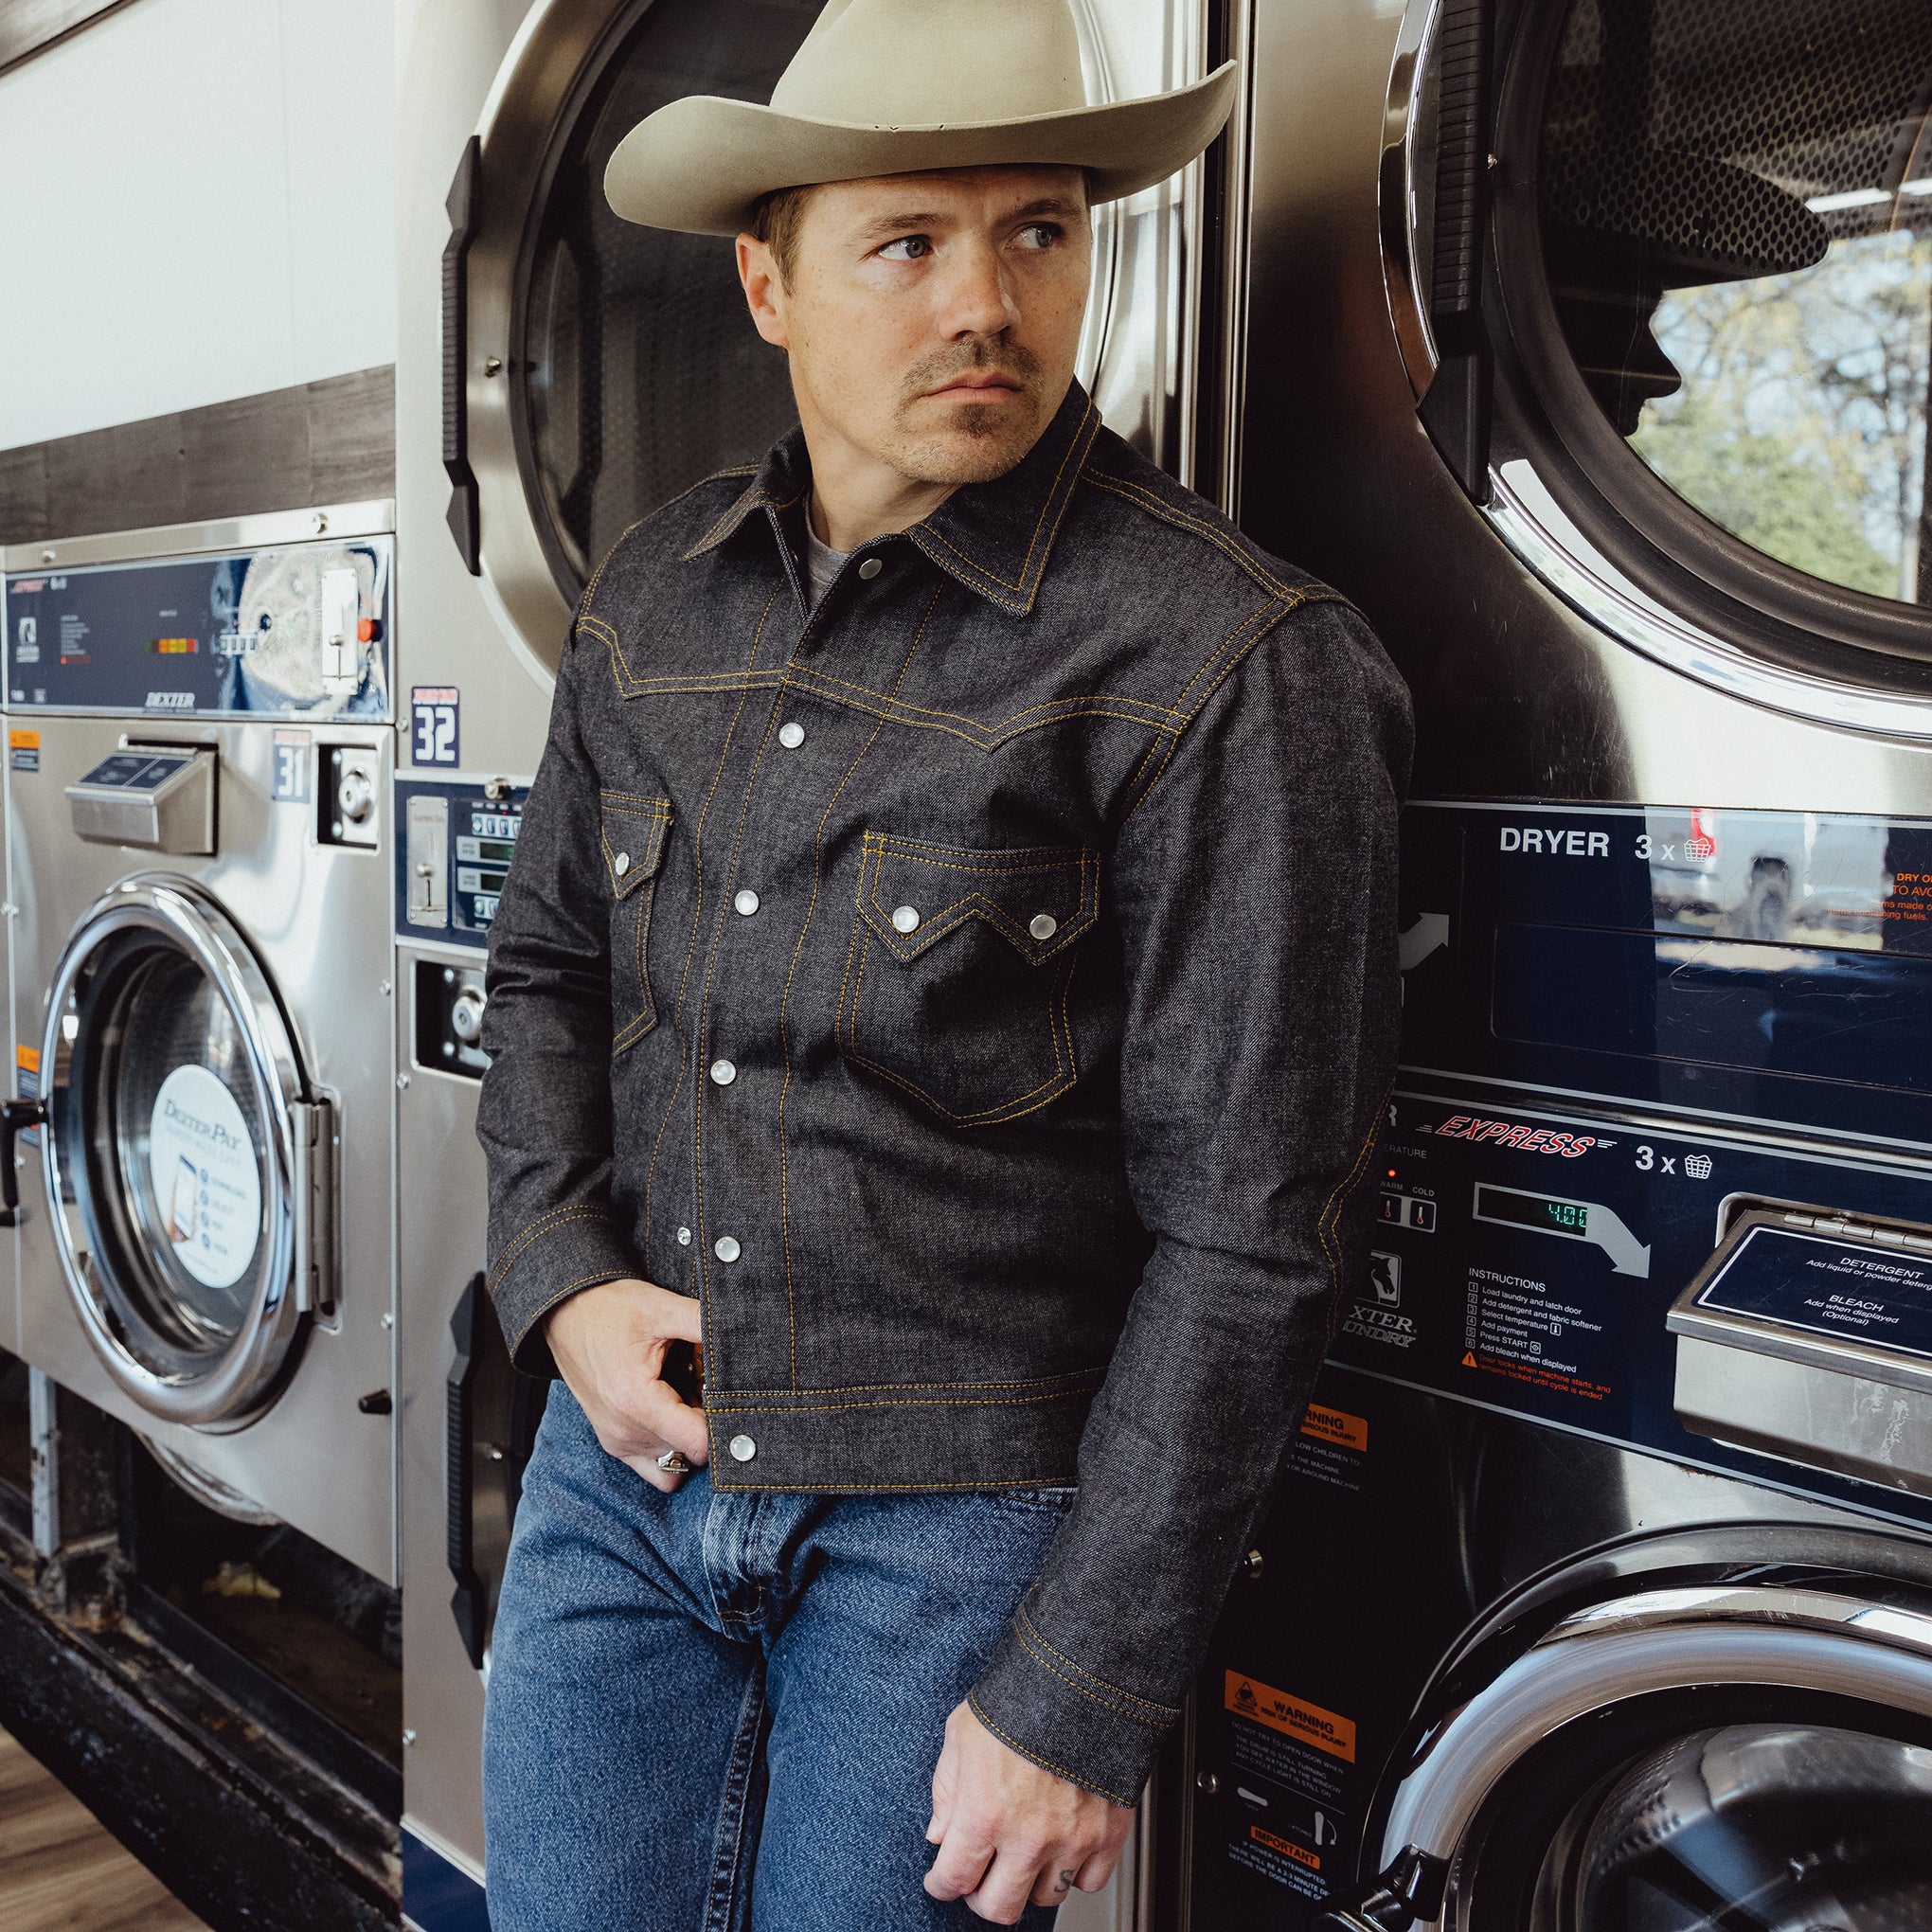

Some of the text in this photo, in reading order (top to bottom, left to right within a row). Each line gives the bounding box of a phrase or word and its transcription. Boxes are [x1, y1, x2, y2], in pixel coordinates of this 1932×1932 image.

[415, 707, 456, 761] 32
[277, 746, 304, 797] 31
[1500, 828, 1610, 857] DRYER
[1635, 834, 1653, 859] 3
[1892, 885, 1908, 895] TO
[1896, 873, 1920, 882] DRY
[1897, 902, 1923, 910] made
[1435, 1115, 1596, 1157] EXPRESS
[1635, 1145, 1676, 1174] 3 x
[1412, 1187, 1435, 1197] COLD
[1469, 1267, 1547, 1292] INSTRUCTIONS
[1806, 1260, 1827, 1268] Add
[1827, 1262, 1852, 1274] liquid
[1864, 1271, 1901, 1283] powder
[1840, 1257, 1924, 1279] DETERGENT
[1482, 1286, 1500, 1296] Load
[1502, 1290, 1529, 1304] laundry
[1530, 1297, 1544, 1307] and
[1545, 1300, 1563, 1311] latch
[1564, 1305, 1582, 1315] door
[1804, 1298, 1900, 1324] Add when displayed
[1829, 1295, 1885, 1312] BLEACH
[1481, 1309, 1504, 1320] Select
[1505, 1315, 1548, 1331] temperature
[1482, 1297, 1496, 1307] Add
[1498, 1301, 1531, 1316] detergent
[1533, 1309, 1547, 1319] and
[1549, 1313, 1569, 1324] fabric
[1570, 1318, 1602, 1333] softener
[1822, 1310, 1869, 1326] (Optional)
[1480, 1331, 1500, 1342] Press
[1501, 1336, 1529, 1349] START
[1481, 1320, 1495, 1330] Add
[1496, 1326, 1529, 1338] payment
[1480, 1343, 1494, 1352] Add
[1495, 1347, 1519, 1359] bleach
[1520, 1352, 1540, 1364] when
[1542, 1358, 1577, 1373] displayed
[1478, 1353, 1496, 1364] Door
[1497, 1358, 1515, 1369] locks
[1517, 1364, 1537, 1374] when
[1539, 1369, 1569, 1383] machine
[1596, 1384, 1611, 1394] and
[1479, 1364, 1602, 1401] remains locked until cycle is ended
[1331, 1429, 1356, 1442] INJURY
[1297, 1456, 1309, 1465] THE
[1310, 1460, 1340, 1475] MACHINE
[1313, 1445, 1348, 1462] CHILDREN
[1301, 1468, 1329, 1482] AROUND
[1330, 1477, 1360, 1492] MACHINE
[1273, 1700, 1334, 1735] WARNING
[1279, 1714, 1287, 1723] OF
[1289, 1718, 1319, 1737] SERIOUS
[1321, 1729, 1347, 1748] INJURY
[1243, 1725, 1256, 1736] NOT
[1282, 1742, 1301, 1756] OPEN
[1302, 1751, 1322, 1765] DOOR
[1323, 1760, 1344, 1775] WHEN
[1265, 1754, 1288, 1770] WATER
[1298, 1769, 1310, 1780] THE
[1301, 1780, 1319, 1793] STILL
[1255, 1829, 1315, 1865] IMPORTANT
[1249, 1844, 1273, 1858] POWER
[1281, 1859, 1325, 1886] INTERRUPTED
[1255, 1865, 1267, 1875] THE
[1268, 1871, 1287, 1885] DOOR
[1288, 1880, 1302, 1892] CAN
[1303, 1888, 1313, 1898] BE
[1294, 1874, 1318, 1892] MINUTE
